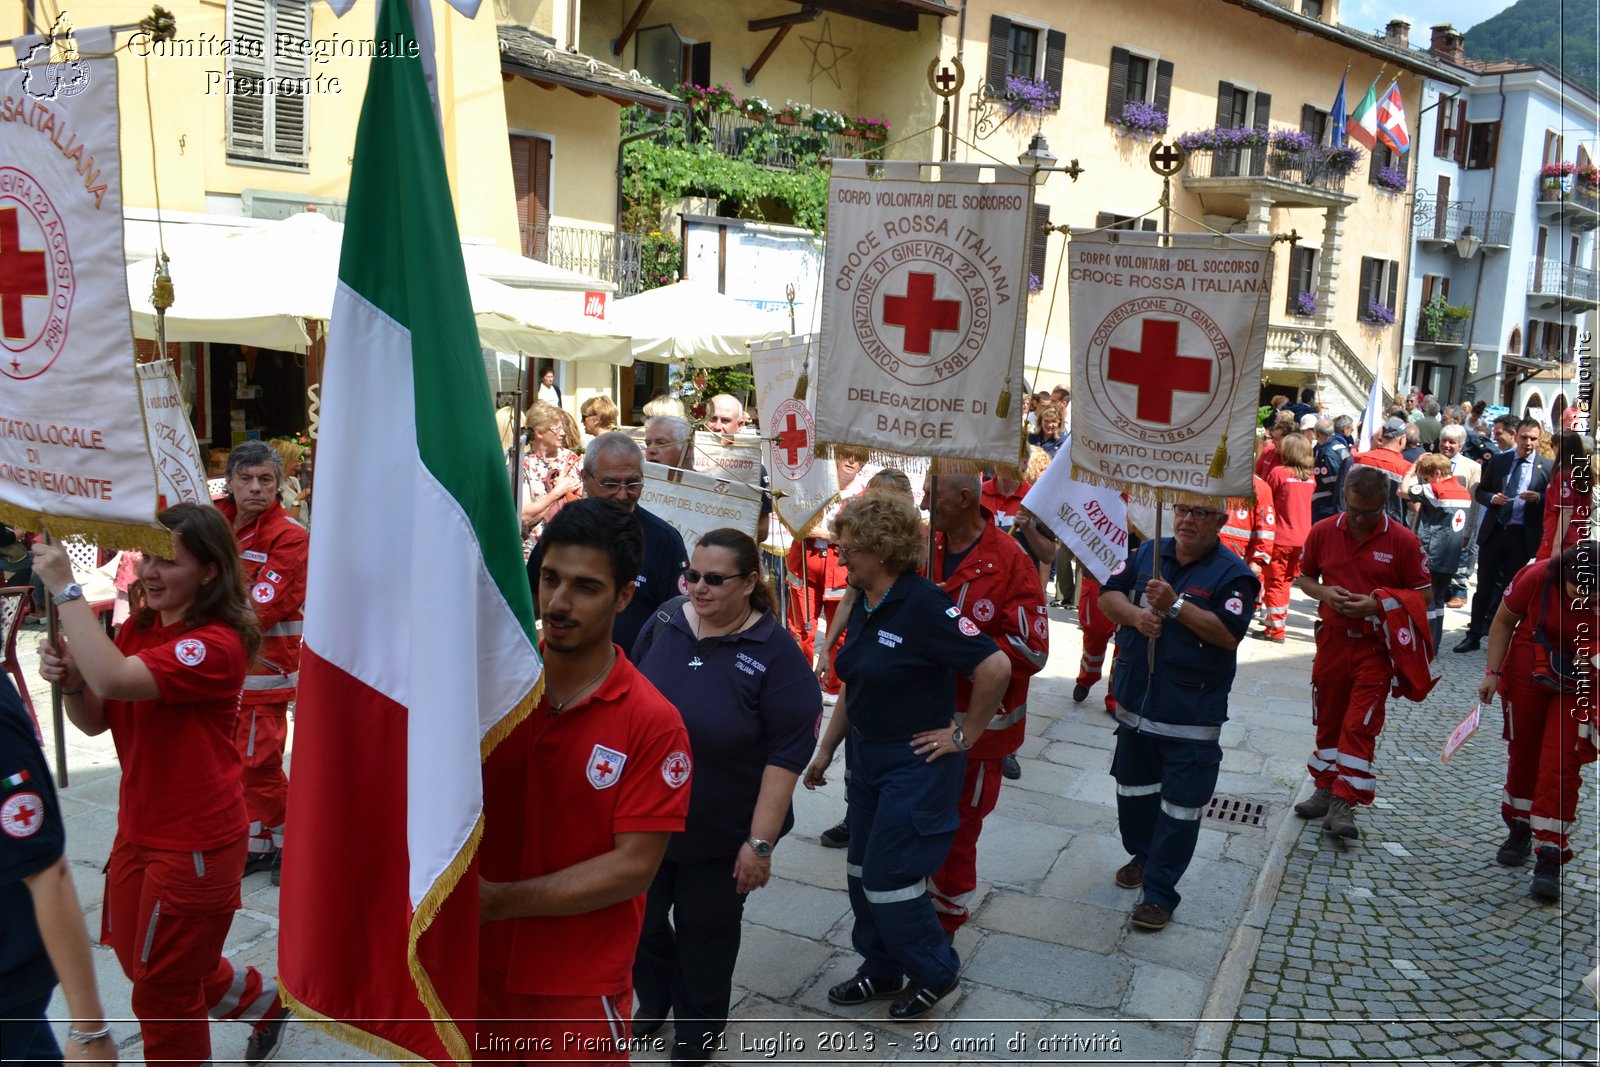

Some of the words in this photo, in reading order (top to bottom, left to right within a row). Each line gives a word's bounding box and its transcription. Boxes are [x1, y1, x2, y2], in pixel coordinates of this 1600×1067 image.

[29, 101, 108, 210] ITALIANA
[32, 194, 50, 221] 22
[838, 188, 871, 206] CORPO
[875, 191, 934, 209] VOLONTARI
[937, 193, 958, 209] DEL
[962, 194, 1022, 211] SOCCORSO
[45, 219, 71, 310] AGOSTO
[835, 230, 881, 292] CROCE
[883, 214, 949, 240] ROSSA
[954, 225, 1011, 306] ITALIANA
[873, 257, 890, 276] DI
[891, 242, 955, 268] GINEVRA
[1080, 251, 1111, 266] CORPO
[1114, 255, 1170, 271] VOLONTARI
[1176, 258, 1198, 273] DEL
[1202, 259, 1260, 274] SOCCORSO
[955, 262, 977, 284] 22
[1070, 267, 1123, 287] CROCE
[1129, 274, 1186, 291] ROSSA
[1191, 277, 1270, 294] ITALIANA
[854, 273, 901, 374] CONVENZIONE
[966, 286, 989, 350] AGOSTO
[1093, 299, 1167, 347] CONVENZIONE
[1173, 301, 1187, 314] DI
[1191, 310, 1231, 362] GINEVRA
[44, 314, 63, 353] 1864
[934, 351, 970, 379] 1864
[848, 387, 965, 413] DELEGAZIONE
[971, 399, 987, 416] DI
[0, 416, 37, 443] TATO
[36, 423, 108, 451] LOCALE
[876, 413, 954, 440] BARGE
[26, 447, 40, 465] DI
[714, 457, 754, 470] SOCCORSO
[1080, 434, 1147, 460] COMITATO
[1152, 449, 1213, 465] LOCALE
[0, 463, 29, 487] ONE
[28, 468, 113, 501] PIEMONTE
[170, 468, 189, 487] 22
[1100, 459, 1211, 488] RACCONIGI
[640, 491, 676, 507] LONTARI
[676, 499, 694, 512] DEL
[694, 501, 742, 520] SOCCORSO
[1083, 499, 1129, 549] SERVIR
